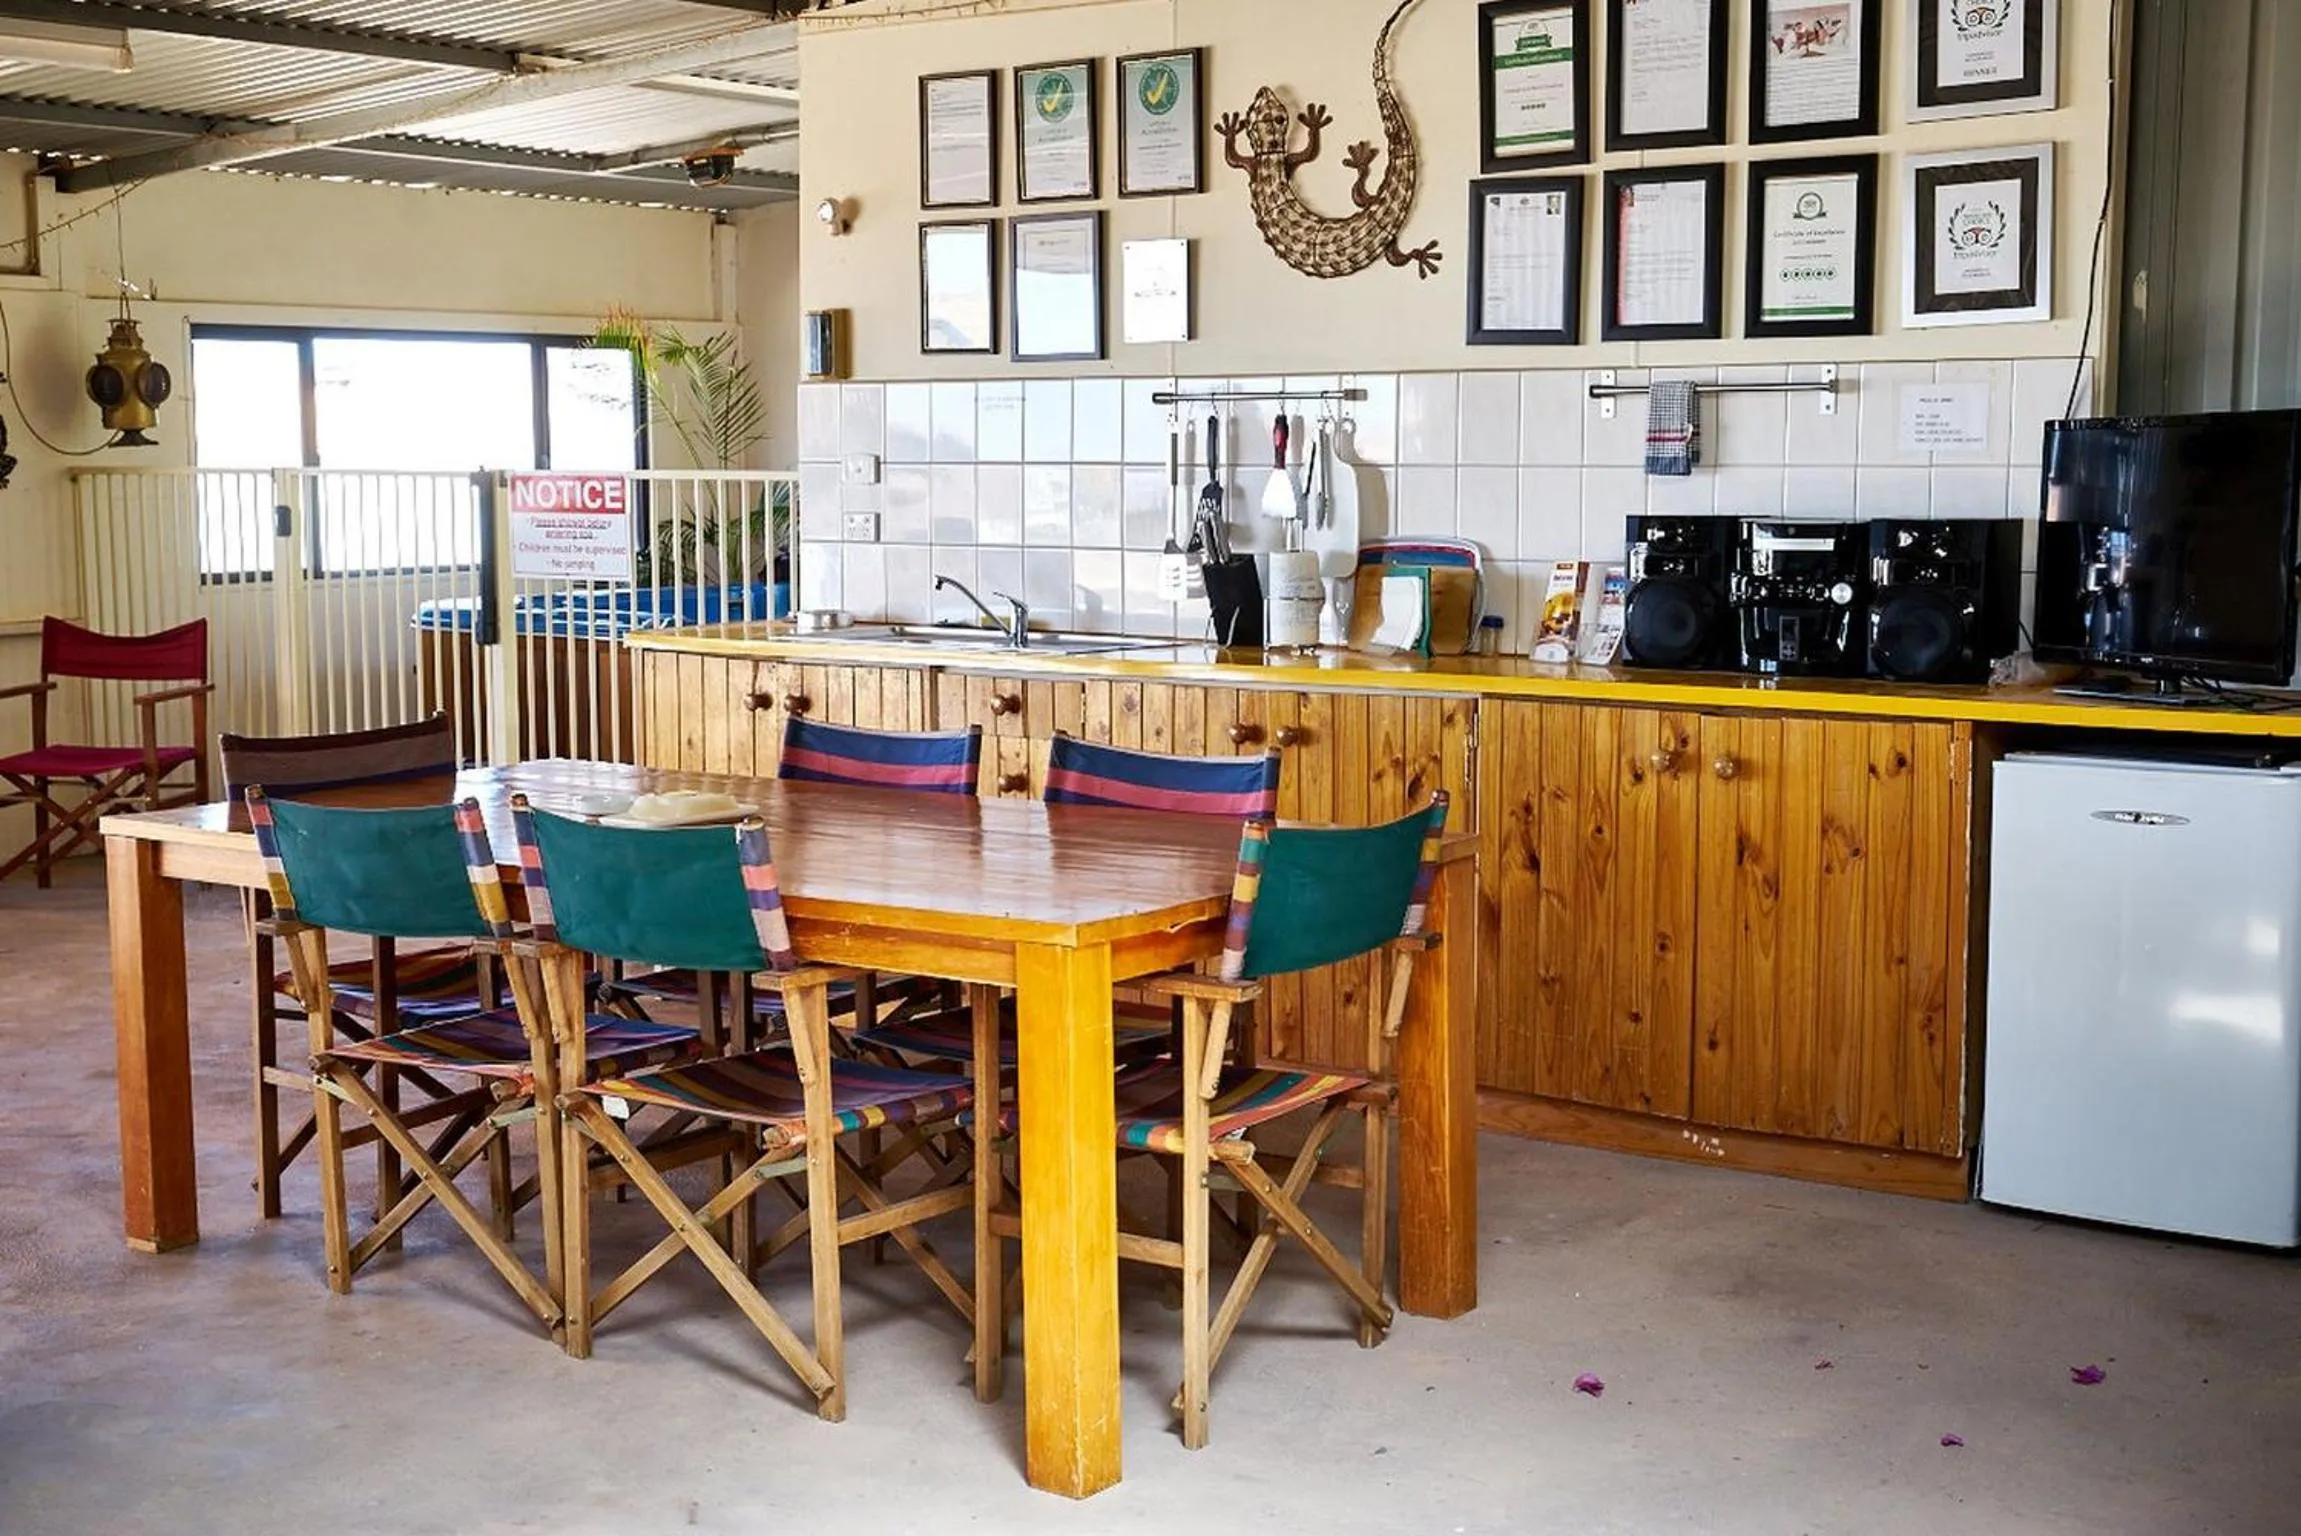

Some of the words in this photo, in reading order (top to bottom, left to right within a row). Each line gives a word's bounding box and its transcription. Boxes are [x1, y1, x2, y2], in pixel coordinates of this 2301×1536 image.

[515, 479, 623, 509] NOTICE
[519, 542, 550, 553] Children
[552, 544, 572, 553] must
[573, 544, 584, 553] be
[551, 558, 562, 568] No
